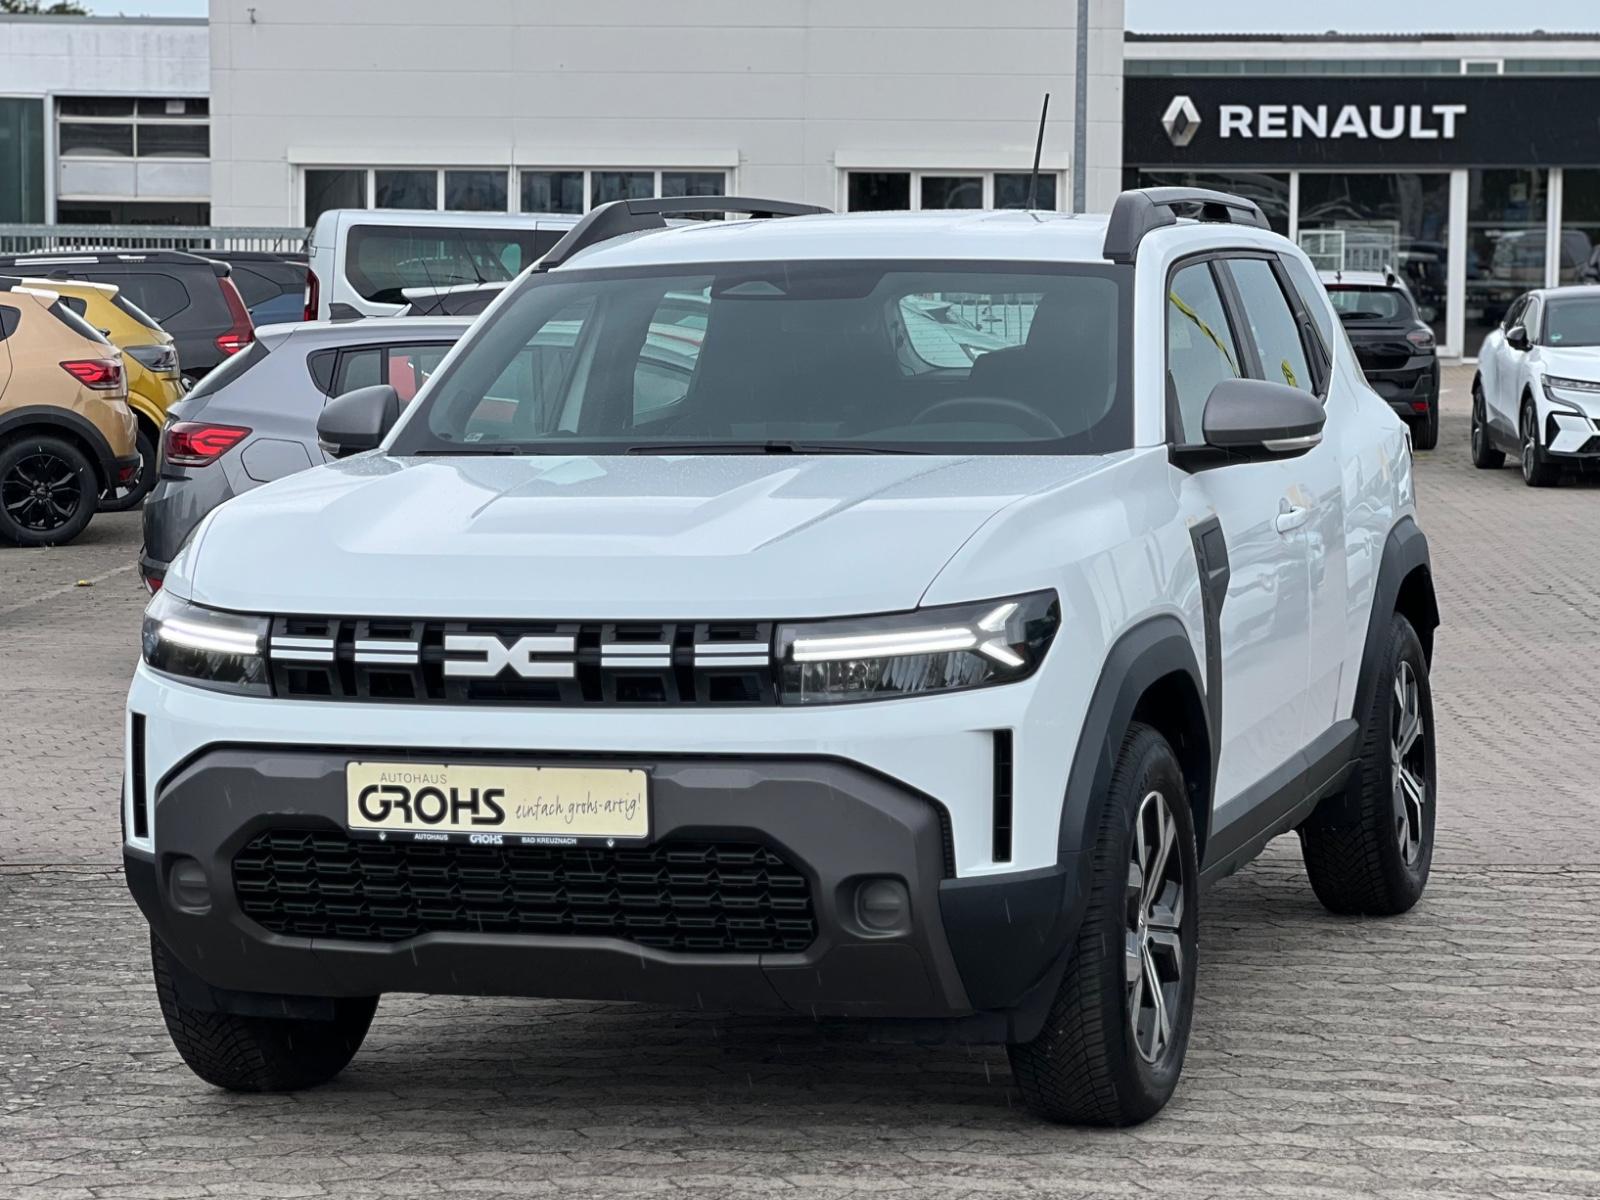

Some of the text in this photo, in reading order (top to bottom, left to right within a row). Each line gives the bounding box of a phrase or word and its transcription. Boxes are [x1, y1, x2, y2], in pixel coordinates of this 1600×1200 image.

[1219, 105, 1467, 139] RENAULT
[380, 772, 447, 784] AUTOHAUS
[358, 784, 505, 825] GROHS
[516, 792, 641, 824] einfach grohs-artig!
[414, 833, 577, 845] AUTOHAUS GROHS BAD KREUZNACH
